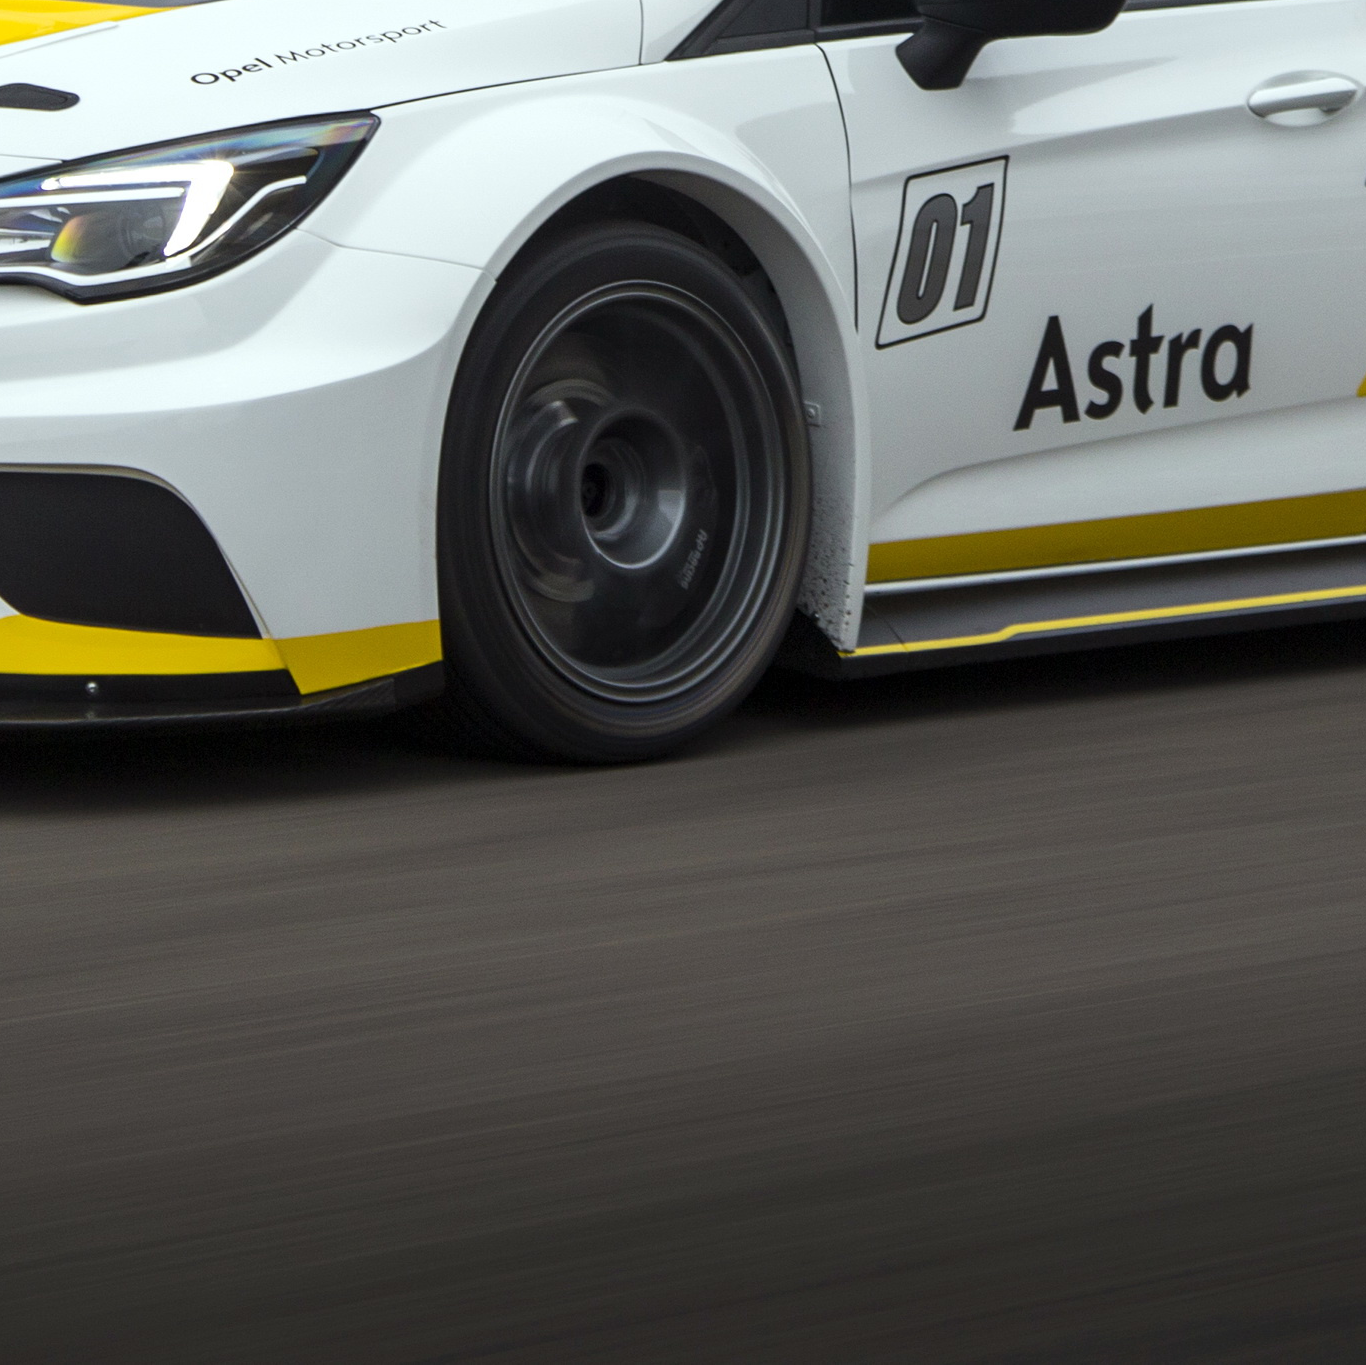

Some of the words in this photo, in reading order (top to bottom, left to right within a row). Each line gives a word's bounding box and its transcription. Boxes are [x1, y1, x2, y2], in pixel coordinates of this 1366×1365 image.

[190, 57, 274, 86] Opel
[274, 19, 447, 65] Motorsport
[896, 183, 995, 324] 01
[1013, 303, 1254, 431] Astra
